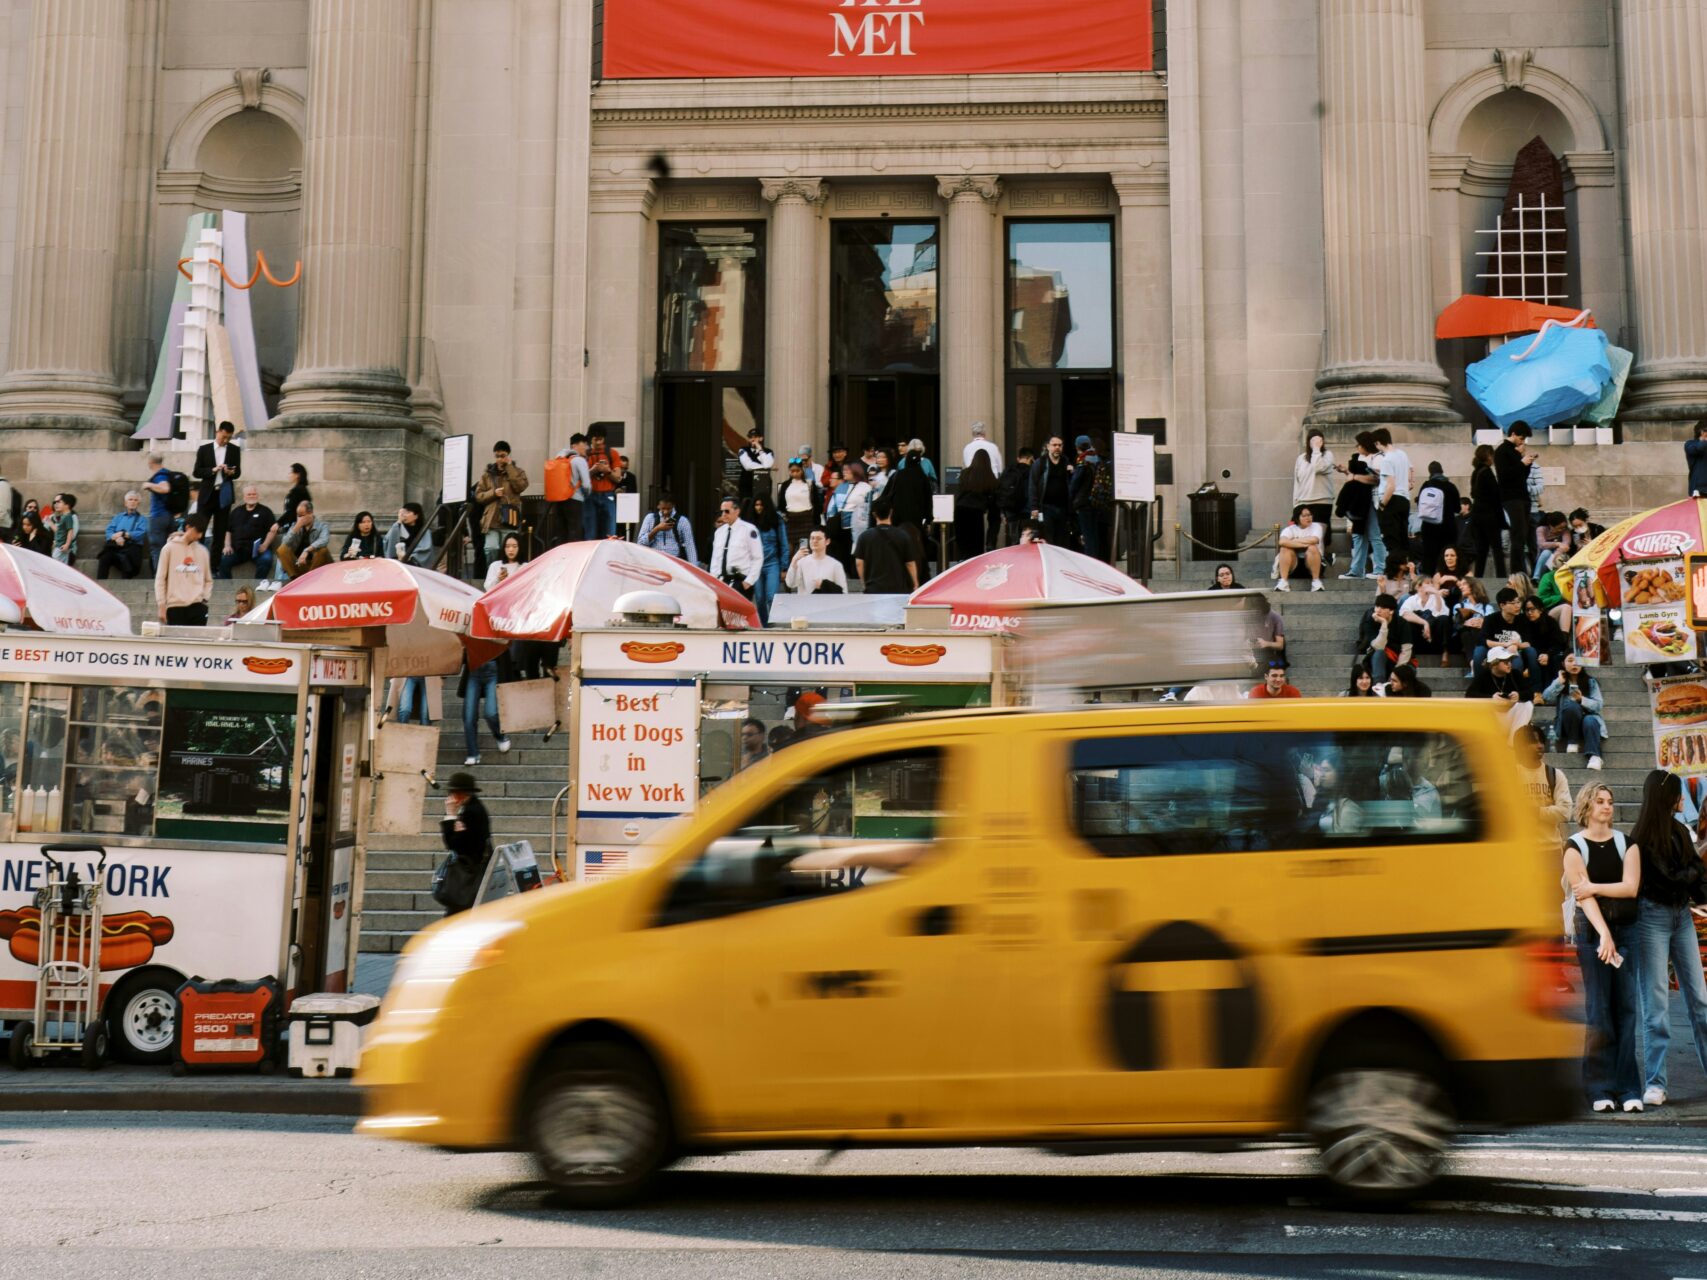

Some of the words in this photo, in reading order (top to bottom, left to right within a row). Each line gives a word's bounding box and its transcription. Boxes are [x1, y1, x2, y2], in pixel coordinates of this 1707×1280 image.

[827, 11, 925, 57] MET
[298, 604, 337, 622] COLD
[339, 601, 393, 620] DRINKS
[440, 608, 461, 624] HOT
[1661, 611, 1678, 620] Gyro
[54, 617, 73, 629] HOT
[75, 618, 105, 631] DOGS
[968, 615, 1022, 628] DRINKS
[14, 649, 50, 661] BEST
[54, 651, 84, 663] HOT
[88, 652, 129, 665] DOGS
[133, 654, 150, 666] IN
[155, 655, 189, 668] NEW
[193, 657, 234, 670] YORK
[722, 641, 775, 664] NEW
[783, 642, 845, 665] YORK
[323, 658, 347, 680] WATER
[616, 694, 659, 712] Best
[592, 724, 626, 741] Hot
[634, 724, 684, 746] Dogs
[181, 756, 213, 767] MARINES
[627, 753, 646, 771] in
[588, 783, 632, 801] New
[639, 784, 685, 802] York
[193, 1012, 256, 1021] PREDATOR
[193, 1024, 229, 1034] 3500
